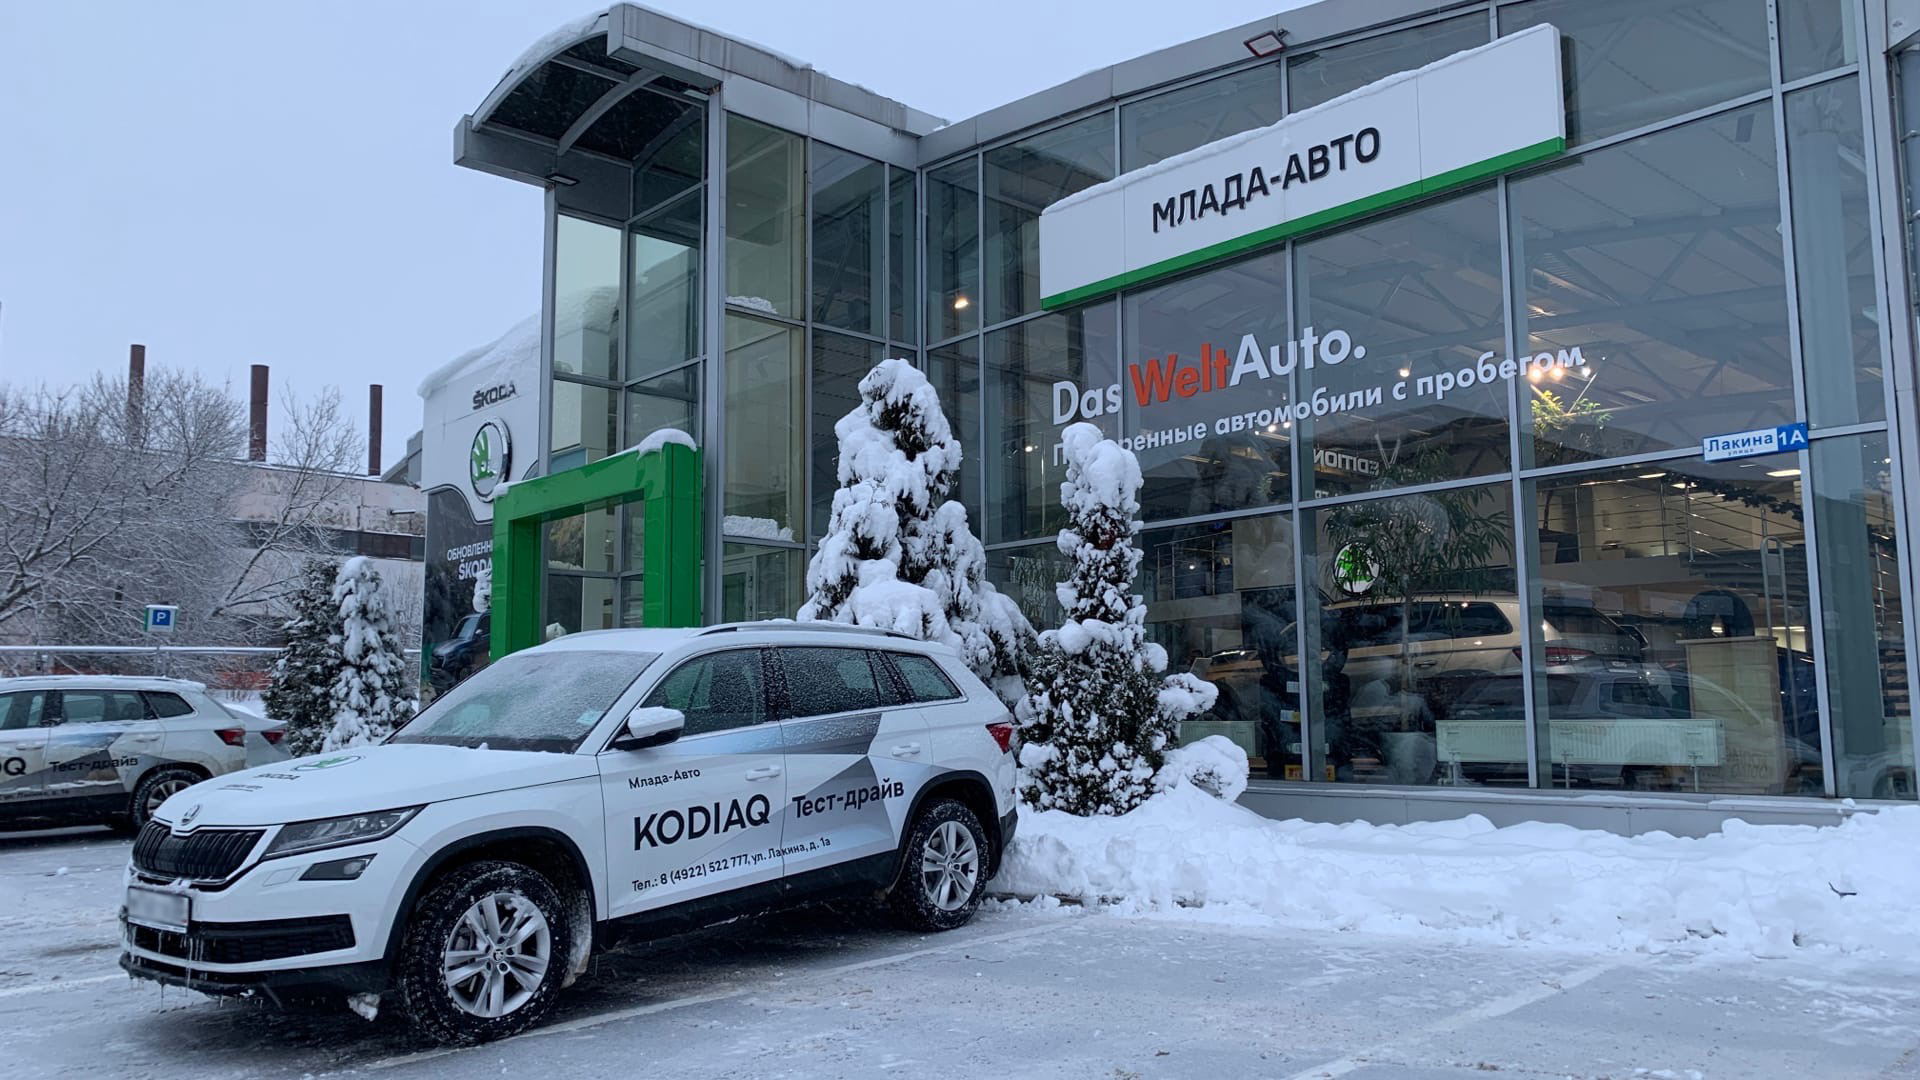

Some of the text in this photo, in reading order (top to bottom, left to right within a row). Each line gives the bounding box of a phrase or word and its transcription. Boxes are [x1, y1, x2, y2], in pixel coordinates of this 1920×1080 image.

[1152, 127, 1381, 233] МЛАДА-АВТО
[1052, 380, 1123, 425] Das
[1053, 346, 1584, 467] Пренные автомобили с пробегом
[1708, 434, 1774, 452] Лакина
[48, 756, 139, 773] Тест-драйв
[628, 767, 701, 790] Млада-Авто
[792, 778, 905, 818] Тест-драйв
[633, 793, 771, 851] KODIAQ
[632, 878, 658, 892] Тел.:
[660, 872, 668, 885] 8
[670, 863, 707, 885] (4922)
[709, 858, 730, 873] 522
[751, 852, 767, 865] ул.
[768, 842, 809, 859] Лакина,
[809, 841, 820, 851] д.
[819, 836, 831, 847] 1а
